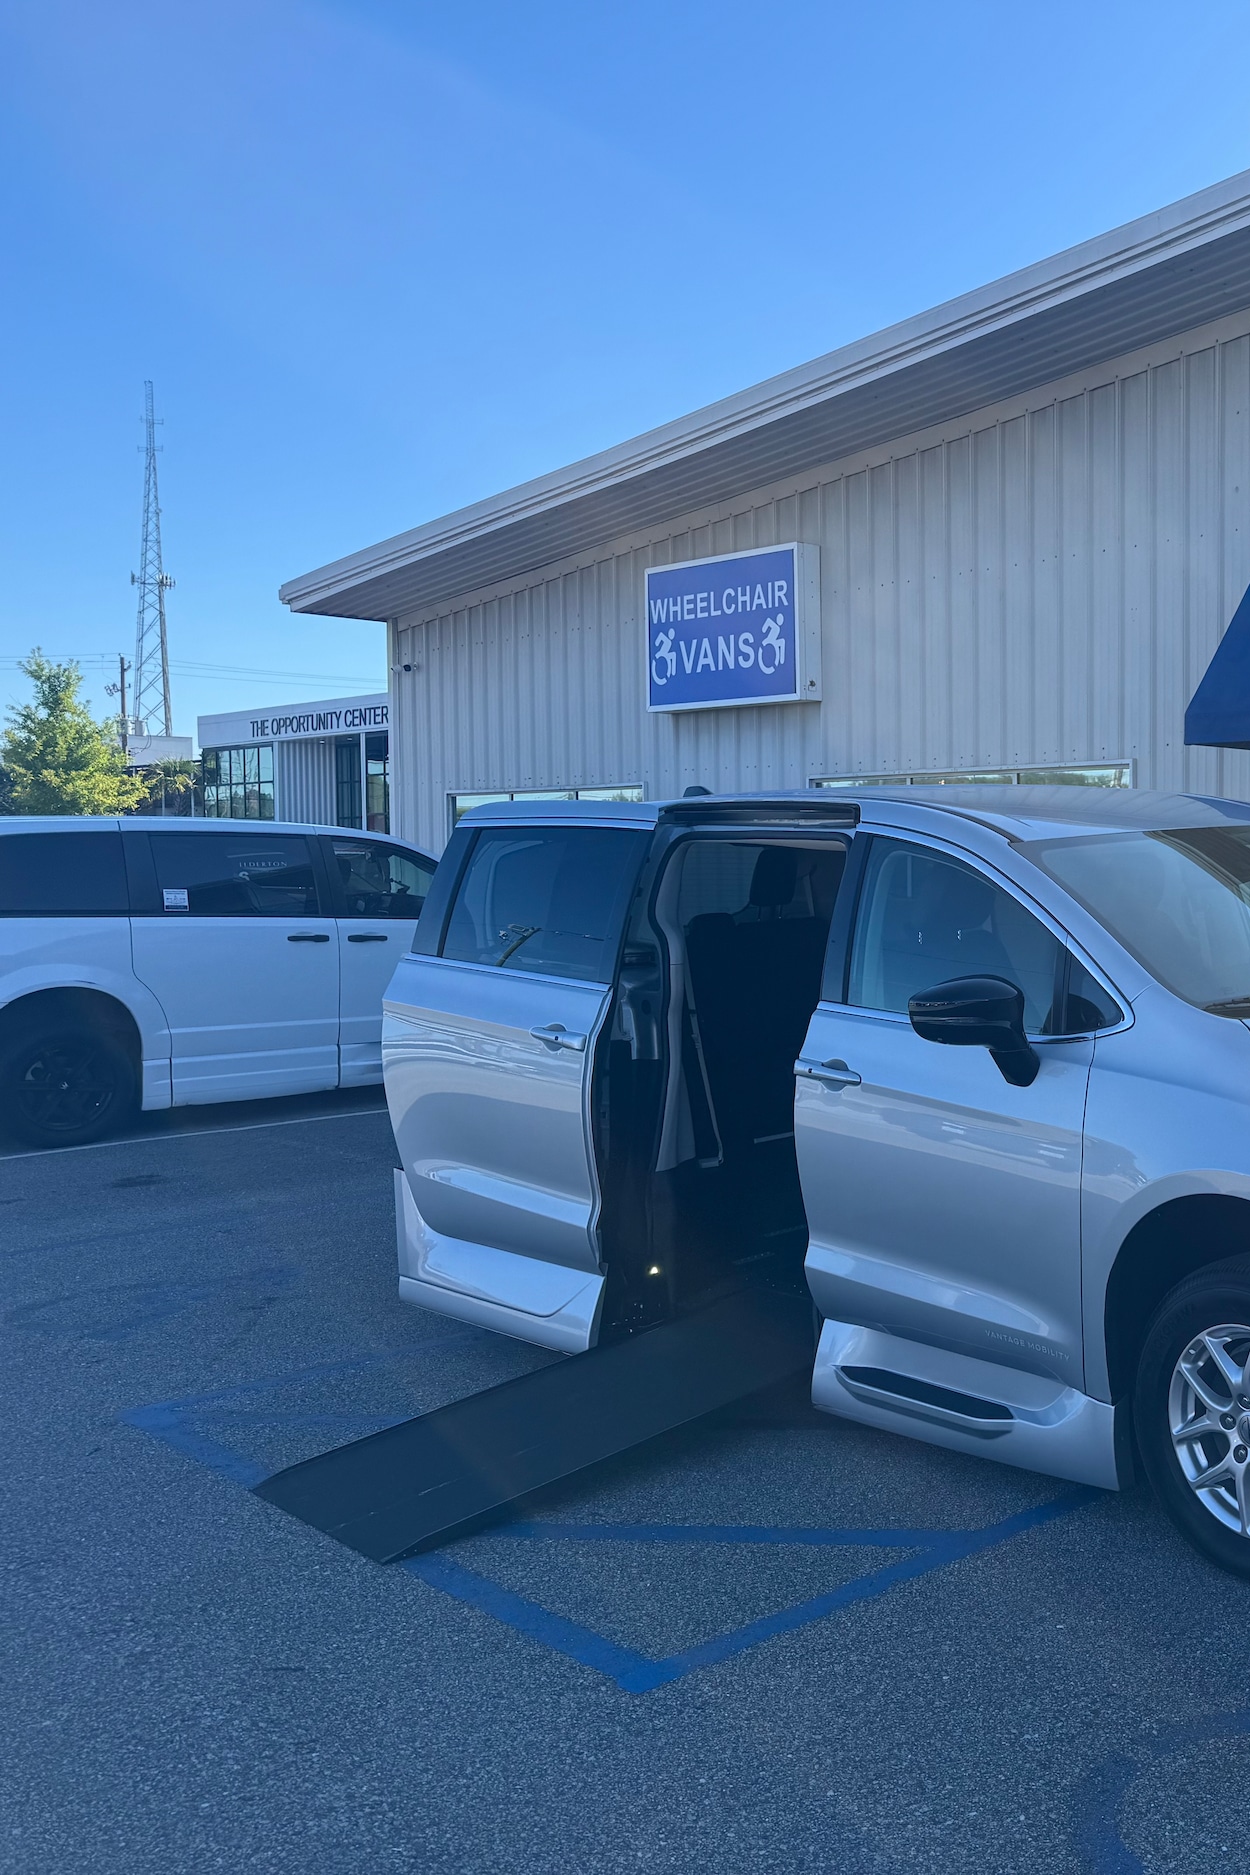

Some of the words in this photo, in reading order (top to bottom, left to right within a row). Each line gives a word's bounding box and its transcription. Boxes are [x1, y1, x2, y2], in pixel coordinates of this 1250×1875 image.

[650, 580, 789, 625] WHEELCHAIR
[679, 632, 756, 675] VANS
[250, 719, 269, 738] THE
[271, 710, 342, 736] OPPORTUNITY
[344, 705, 389, 728] CENTER
[985, 1330, 1026, 1347] VANTAGE
[1027, 1342, 1071, 1361] MOBILITY
